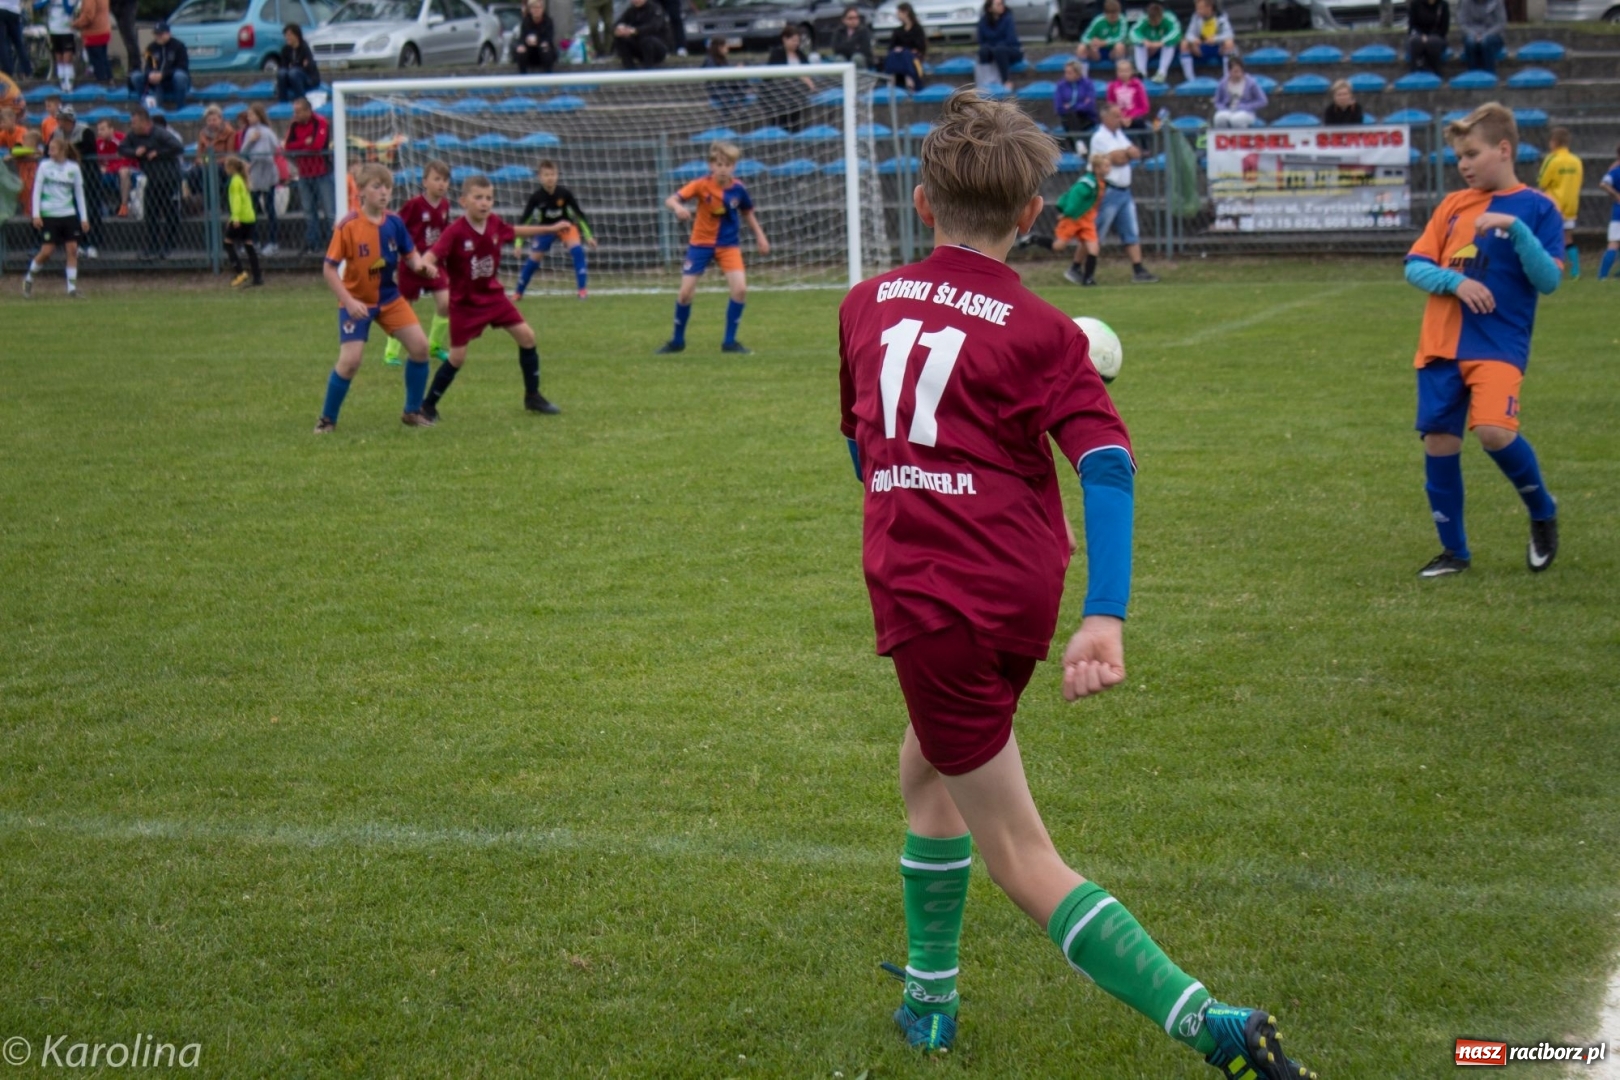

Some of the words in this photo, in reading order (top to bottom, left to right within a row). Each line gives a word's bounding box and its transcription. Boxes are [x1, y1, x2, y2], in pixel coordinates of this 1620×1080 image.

[1215, 133, 1295, 150] DIESEL
[1316, 130, 1404, 148] SERWIS
[358, 243, 370, 258] 15
[876, 277, 933, 303] GÓRKI
[932, 281, 1014, 326] ŚLĄSKIE
[880, 318, 967, 448] 11
